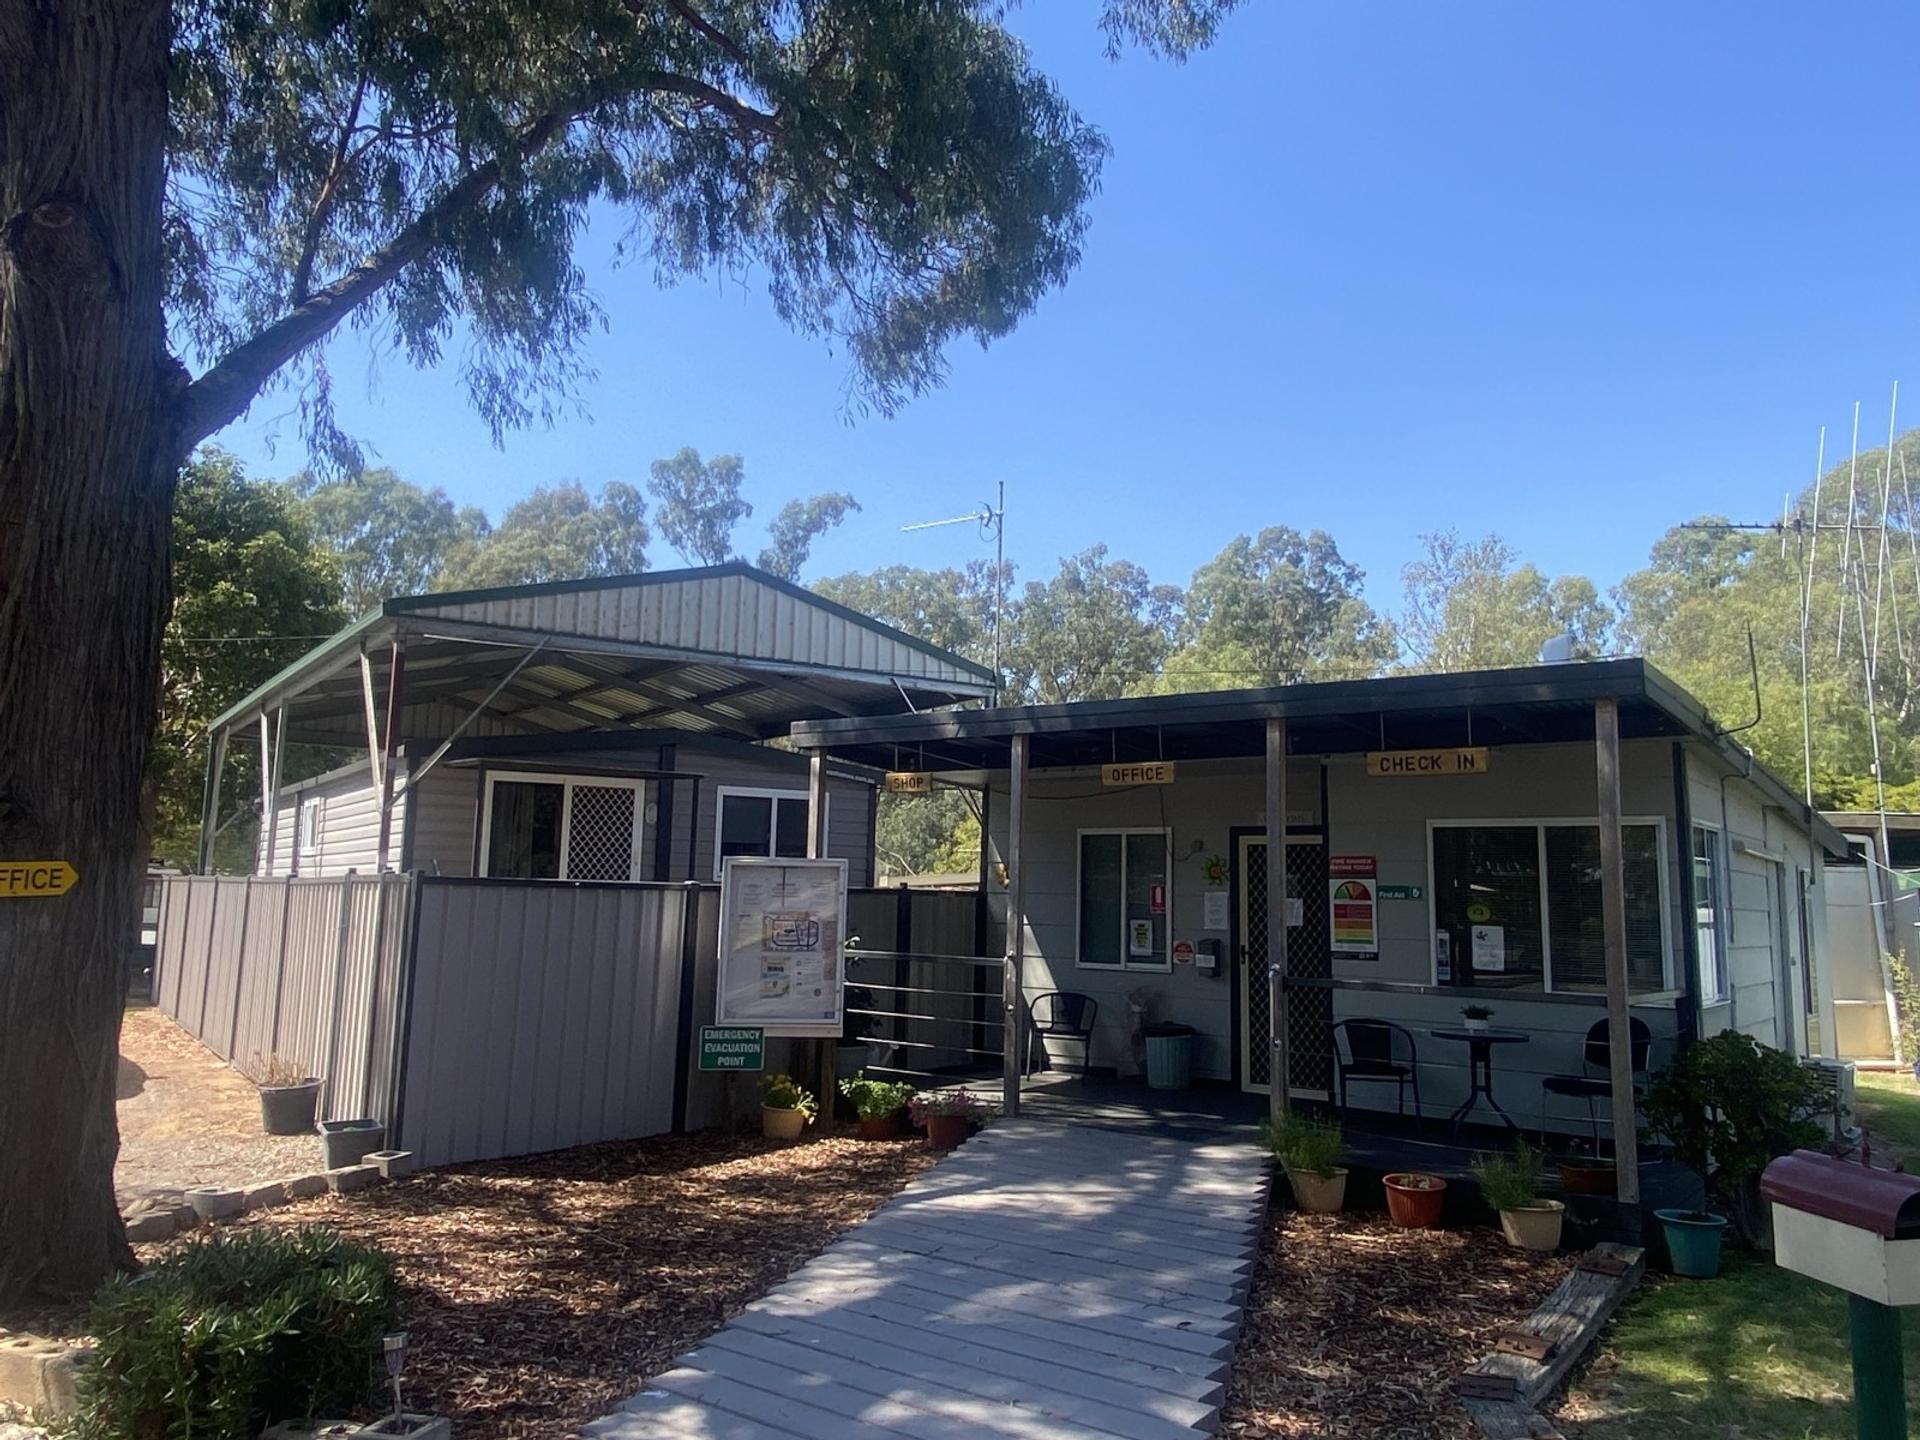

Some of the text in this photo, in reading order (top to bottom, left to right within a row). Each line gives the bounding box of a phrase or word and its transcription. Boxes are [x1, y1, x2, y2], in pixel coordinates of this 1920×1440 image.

[1380, 753, 1475, 773] CHECK IN
[1111, 766, 1165, 782] OFFICE
[893, 776, 924, 790] SHOP
[704, 1030, 760, 1040] EMERGENCY
[704, 1043, 761, 1054] EVACUATION
[717, 1056, 745, 1067] POINT
